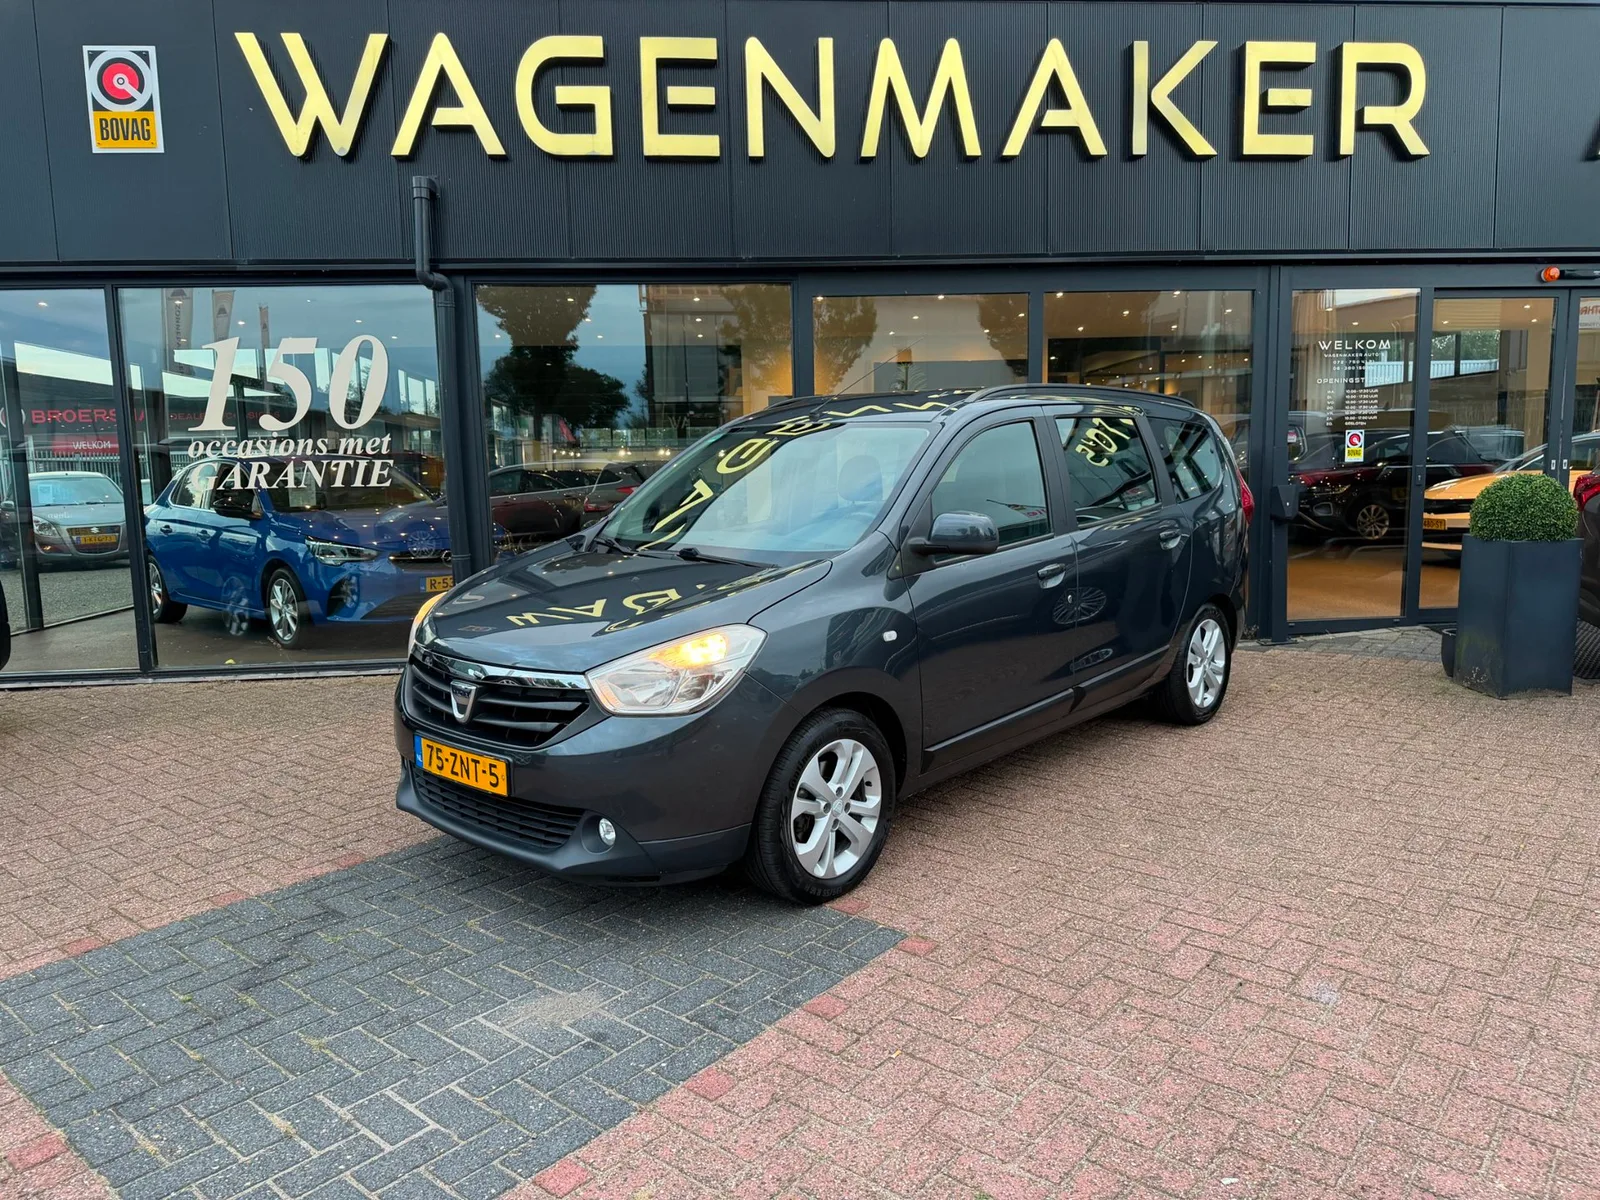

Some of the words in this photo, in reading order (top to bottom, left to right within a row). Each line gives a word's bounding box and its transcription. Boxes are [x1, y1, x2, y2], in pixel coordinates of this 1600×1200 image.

[234, 32, 1431, 158] WAGENMAKER
[99, 117, 151, 141] BOVAG
[1318, 339, 1391, 350] WELKOM
[188, 334, 389, 431] 150
[72, 440, 112, 450] WELKOM
[188, 431, 328, 458] occasions
[337, 432, 391, 456] met
[191, 459, 394, 491] GARANTIE
[425, 743, 500, 788] 75-ZNT-5
